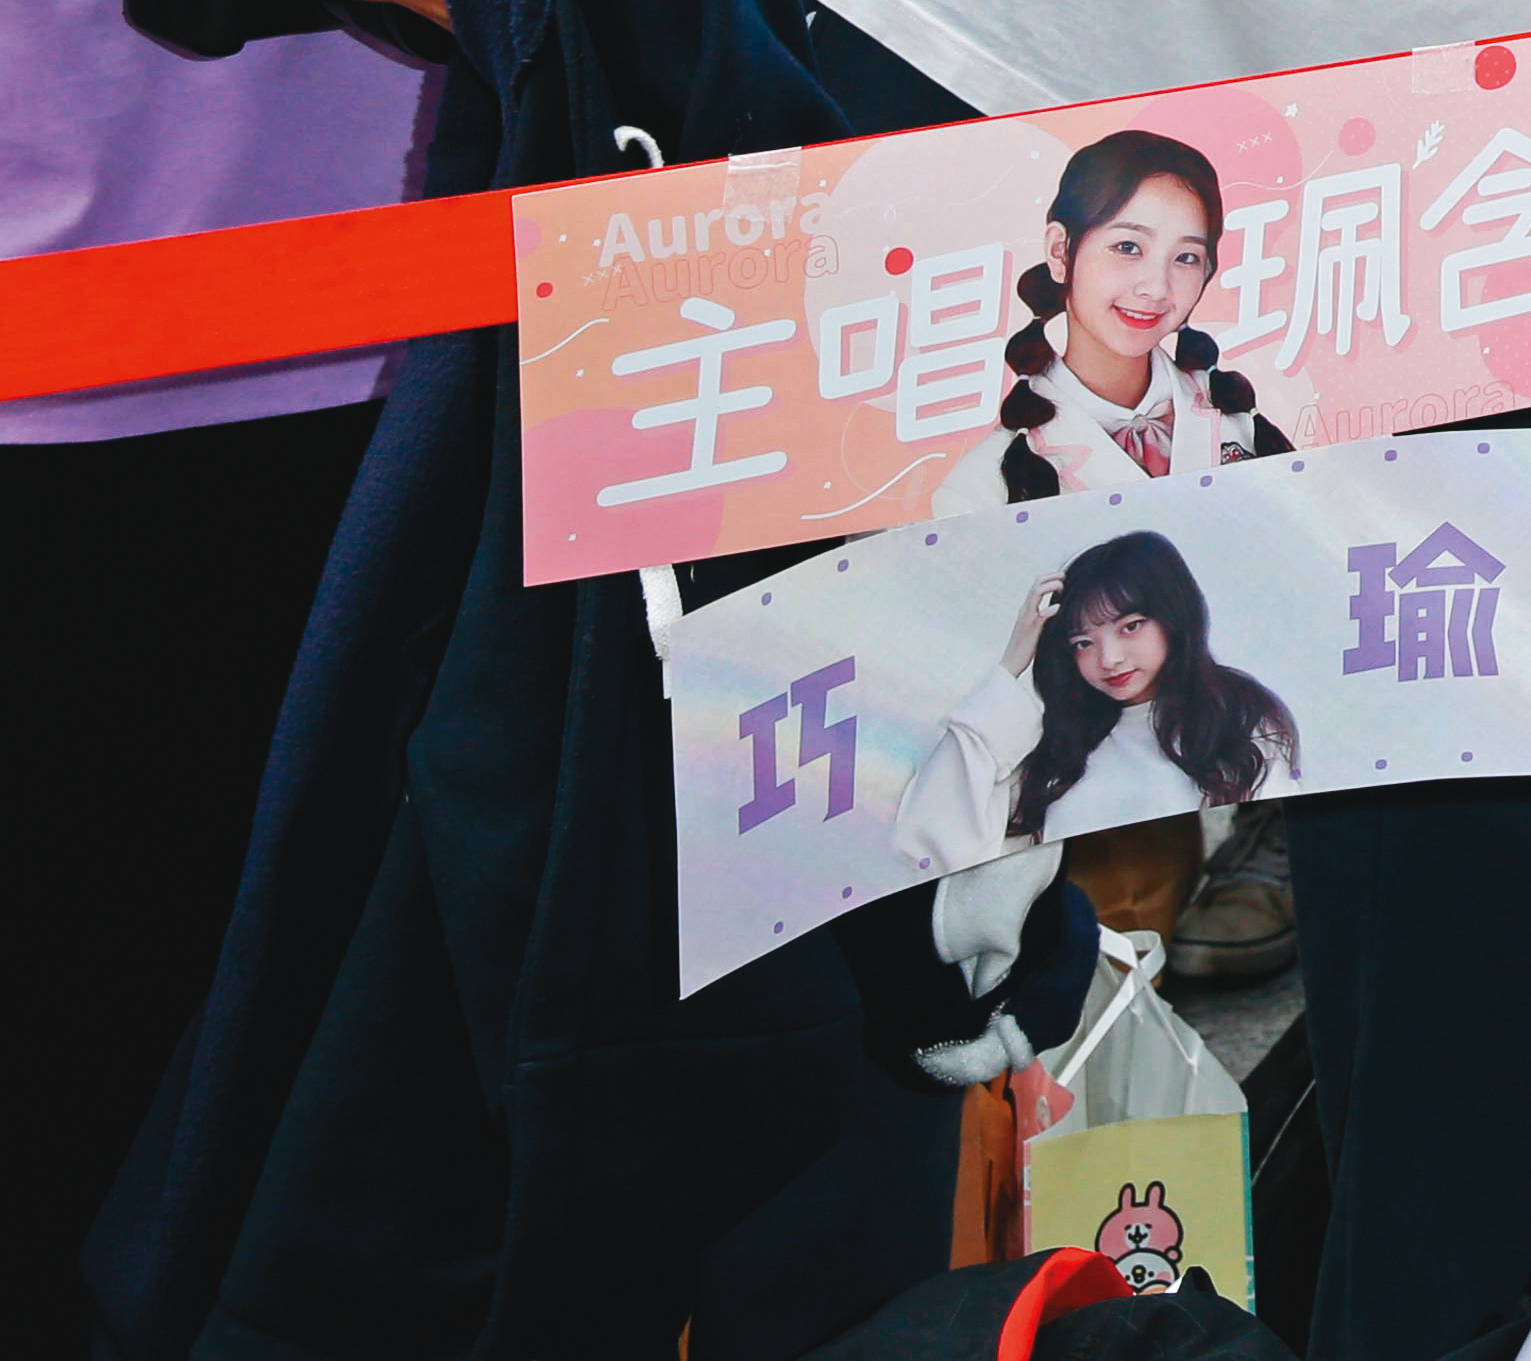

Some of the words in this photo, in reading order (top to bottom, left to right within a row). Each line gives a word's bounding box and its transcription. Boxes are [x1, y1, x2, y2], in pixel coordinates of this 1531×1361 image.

[599, 177, 832, 267] Aurora
[594, 242, 1012, 509] 主唱
[737, 655, 857, 836] 巧
[1341, 520, 1508, 682] 瑜
